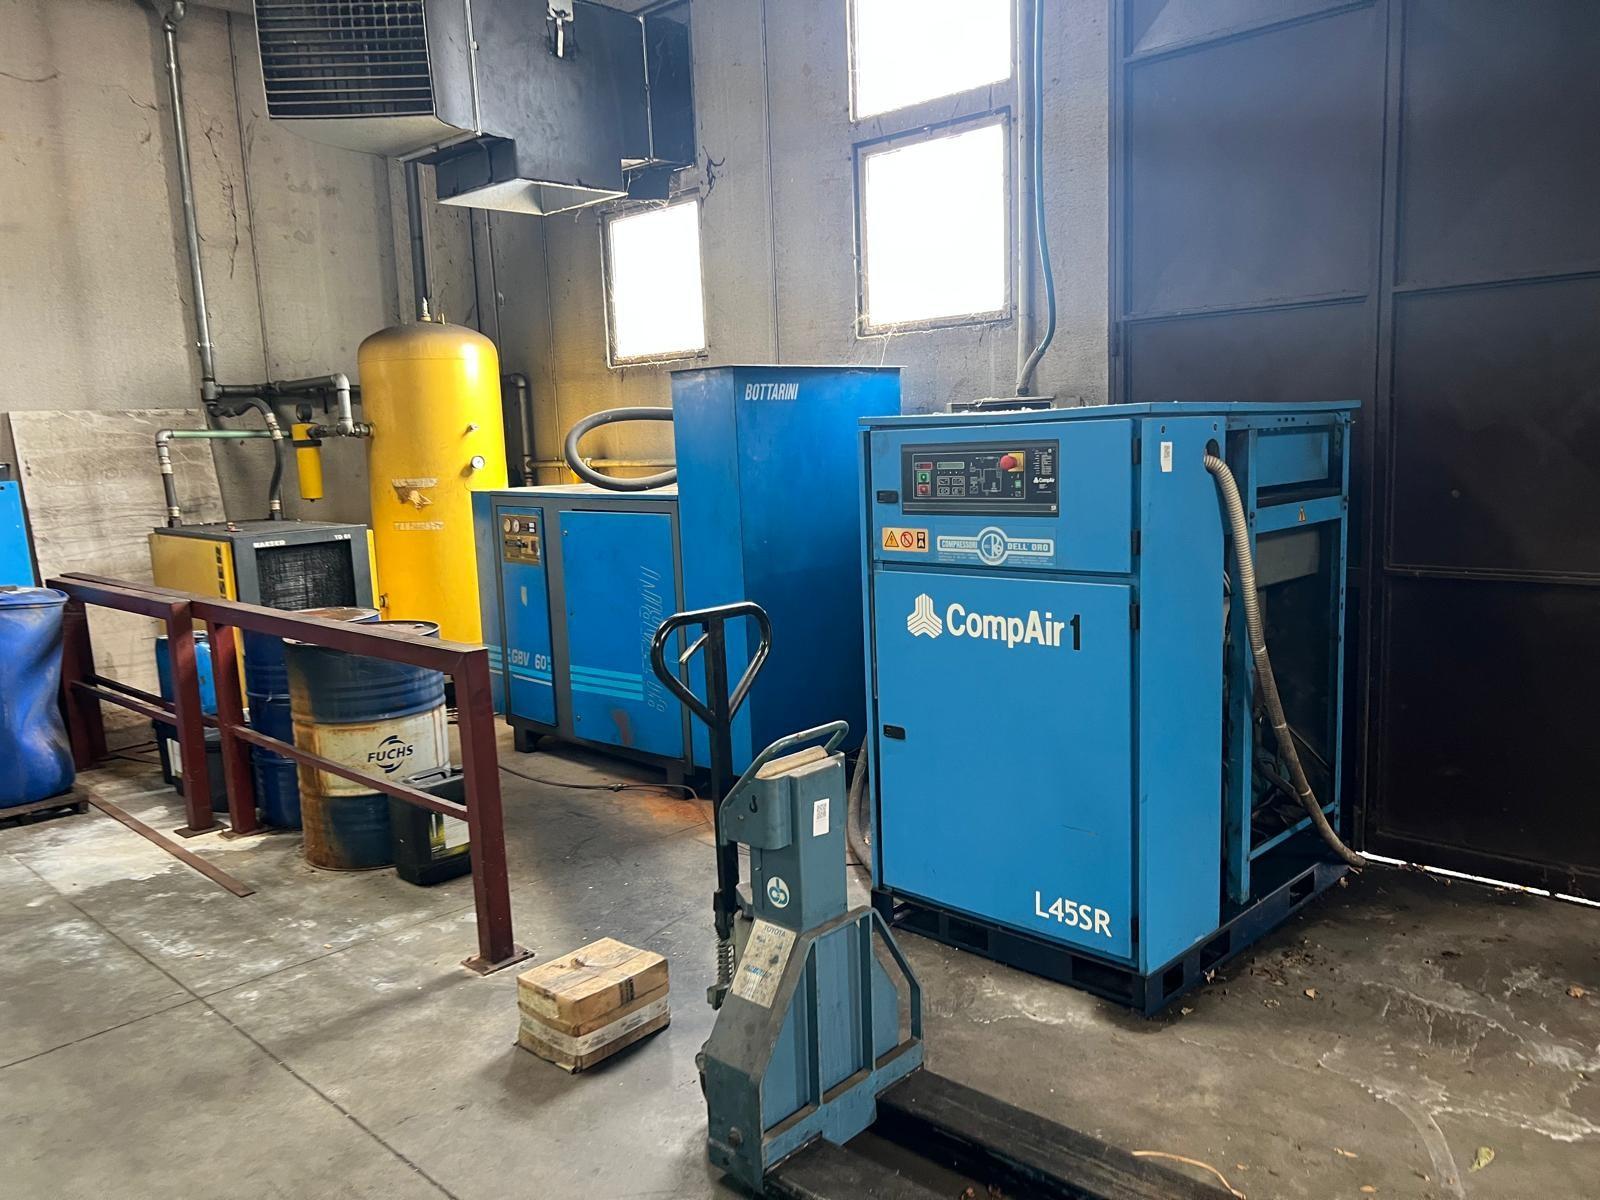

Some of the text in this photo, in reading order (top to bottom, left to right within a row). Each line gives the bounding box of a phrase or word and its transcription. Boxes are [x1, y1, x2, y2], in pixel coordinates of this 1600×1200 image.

[744, 382, 800, 402] BOTTARINI
[1031, 542, 1050, 552] ORO
[946, 602, 1065, 649] CompAir
[511, 649, 547, 670] GBV 60
[367, 744, 414, 763] FUCHS
[1035, 890, 1113, 938] L45SR
